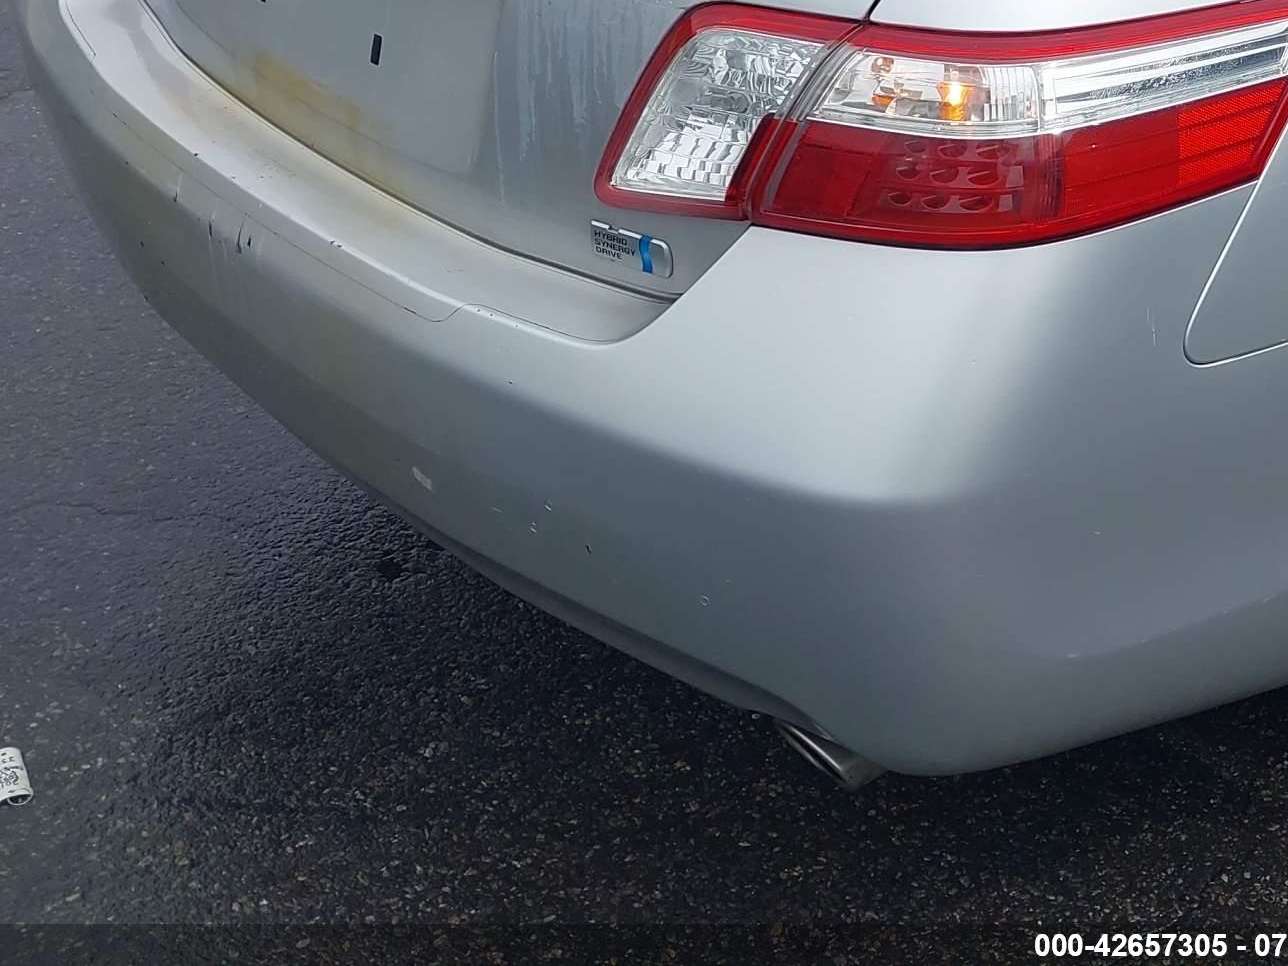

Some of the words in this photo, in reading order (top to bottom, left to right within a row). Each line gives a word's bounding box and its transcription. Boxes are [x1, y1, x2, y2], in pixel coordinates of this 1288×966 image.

[594, 229, 628, 245] HYBRID
[594, 238, 636, 256] SYNERGY
[595, 246, 623, 259] DRIVE
